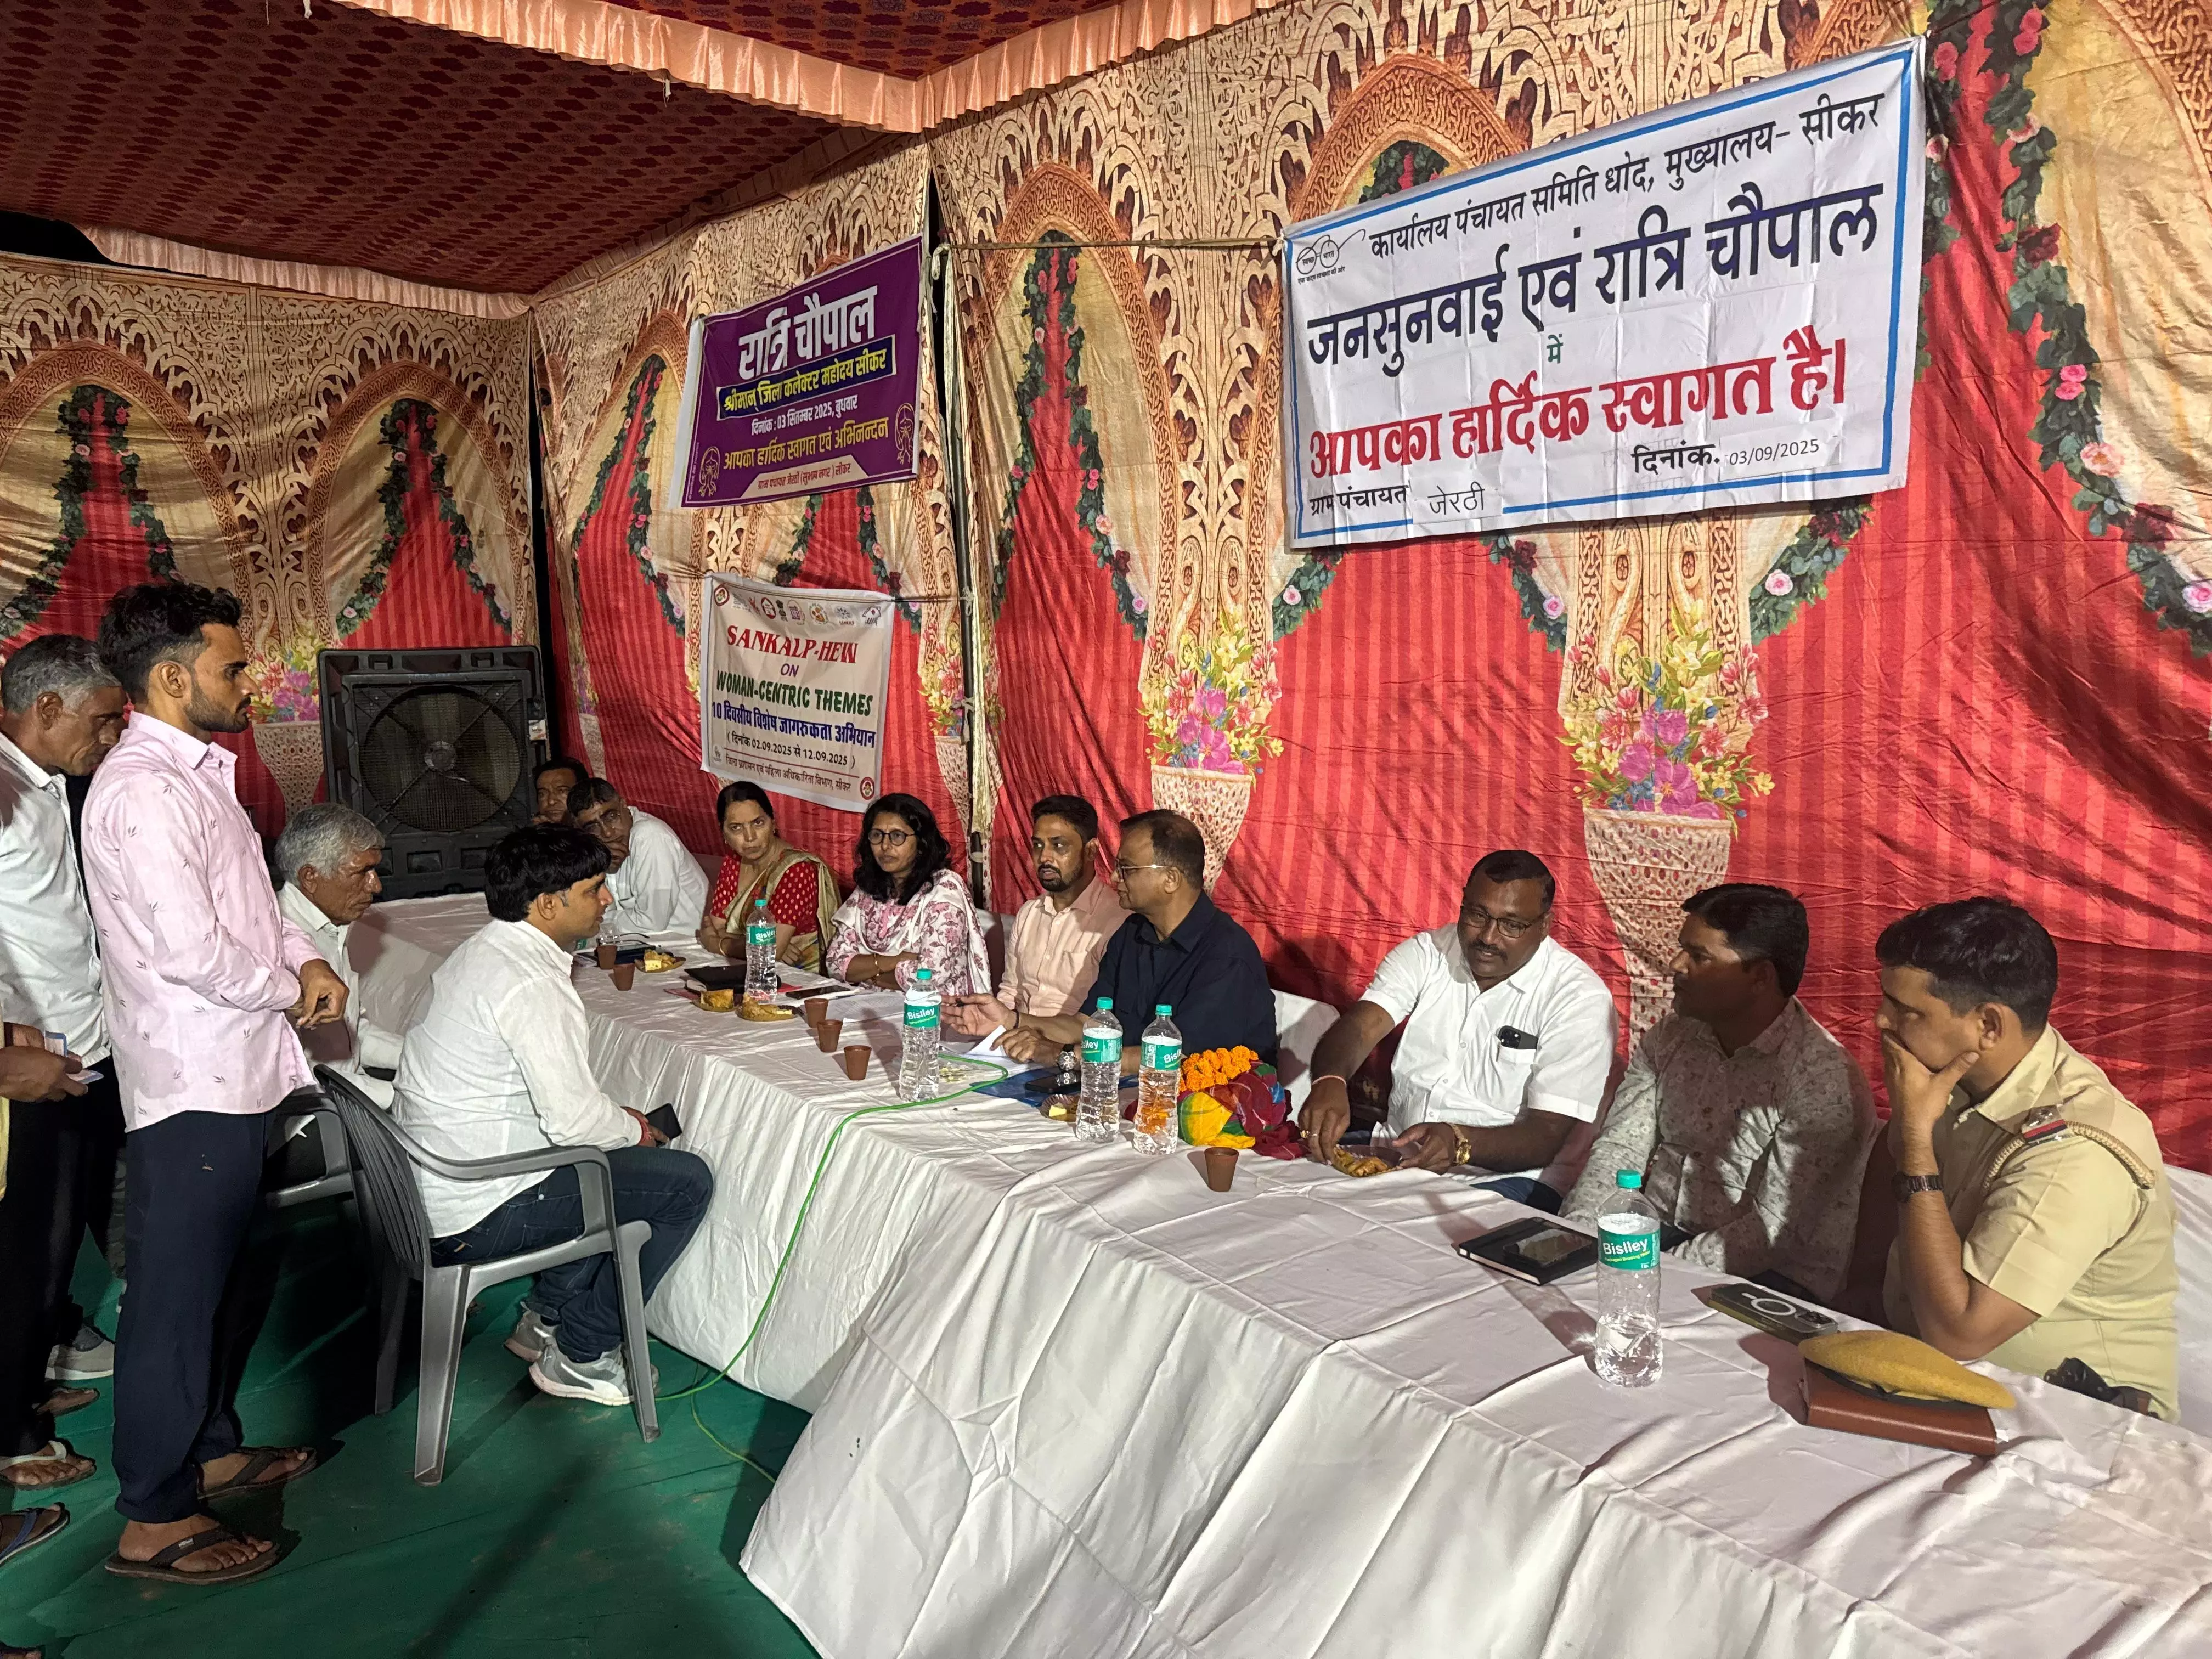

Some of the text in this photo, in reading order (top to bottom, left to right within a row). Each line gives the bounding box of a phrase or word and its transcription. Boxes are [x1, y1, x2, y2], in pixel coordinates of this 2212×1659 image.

[1369, 213, 1451, 258] कार्यालय
[1455, 199, 1526, 234] पंचायत
[1531, 172, 1599, 217] समिति
[1605, 151, 1654, 194] धोद,
[1799, 93, 1885, 145] सीकर
[1307, 182, 1884, 377] जनसुनवाई एवं रात्रि चौपाल
[738, 285, 878, 380] रात्रि चौपाल
[1547, 334, 1563, 364] में
[724, 348, 887, 411] श्रीमान् जिला कलेक्टर महोदय सीकर
[777, 415, 786, 429] 03
[787, 408, 813, 426] सितम्बर
[814, 400, 834, 419] 2025,
[835, 394, 858, 418] बुधवार
[1310, 324, 1846, 478] आपका हार्दिक स्वागत है।
[724, 417, 889, 470] आपका हार्दिक स्वागत एवं अभिनन्दन
[1729, 438, 1820, 467] 03/09/2025
[836, 462, 851, 476] सीकर
[1310, 481, 1486, 516] ग्राम पंचायत जेरठी
[727, 625, 858, 663] SANKALP-HEW
[780, 663, 799, 677] ON
[716, 670, 873, 716] WOMAN-CENTRIC THEMES
[712, 702, 722, 719] 10
[724, 699, 752, 727] दिवसीय
[753, 707, 777, 731] विशेष
[835, 722, 876, 748] अभियान
[752, 738, 792, 755] 02.09.2025
[793, 744, 801, 758] से
[804, 749, 848, 766] 12.09.2025
[726, 754, 737, 766] जिला
[782, 768, 814, 785] अधिकारिता
[836, 778, 851, 792] सीकर
[907, 1007, 935, 1020] Bislley
[1602, 1238, 1647, 1255] Bislley
